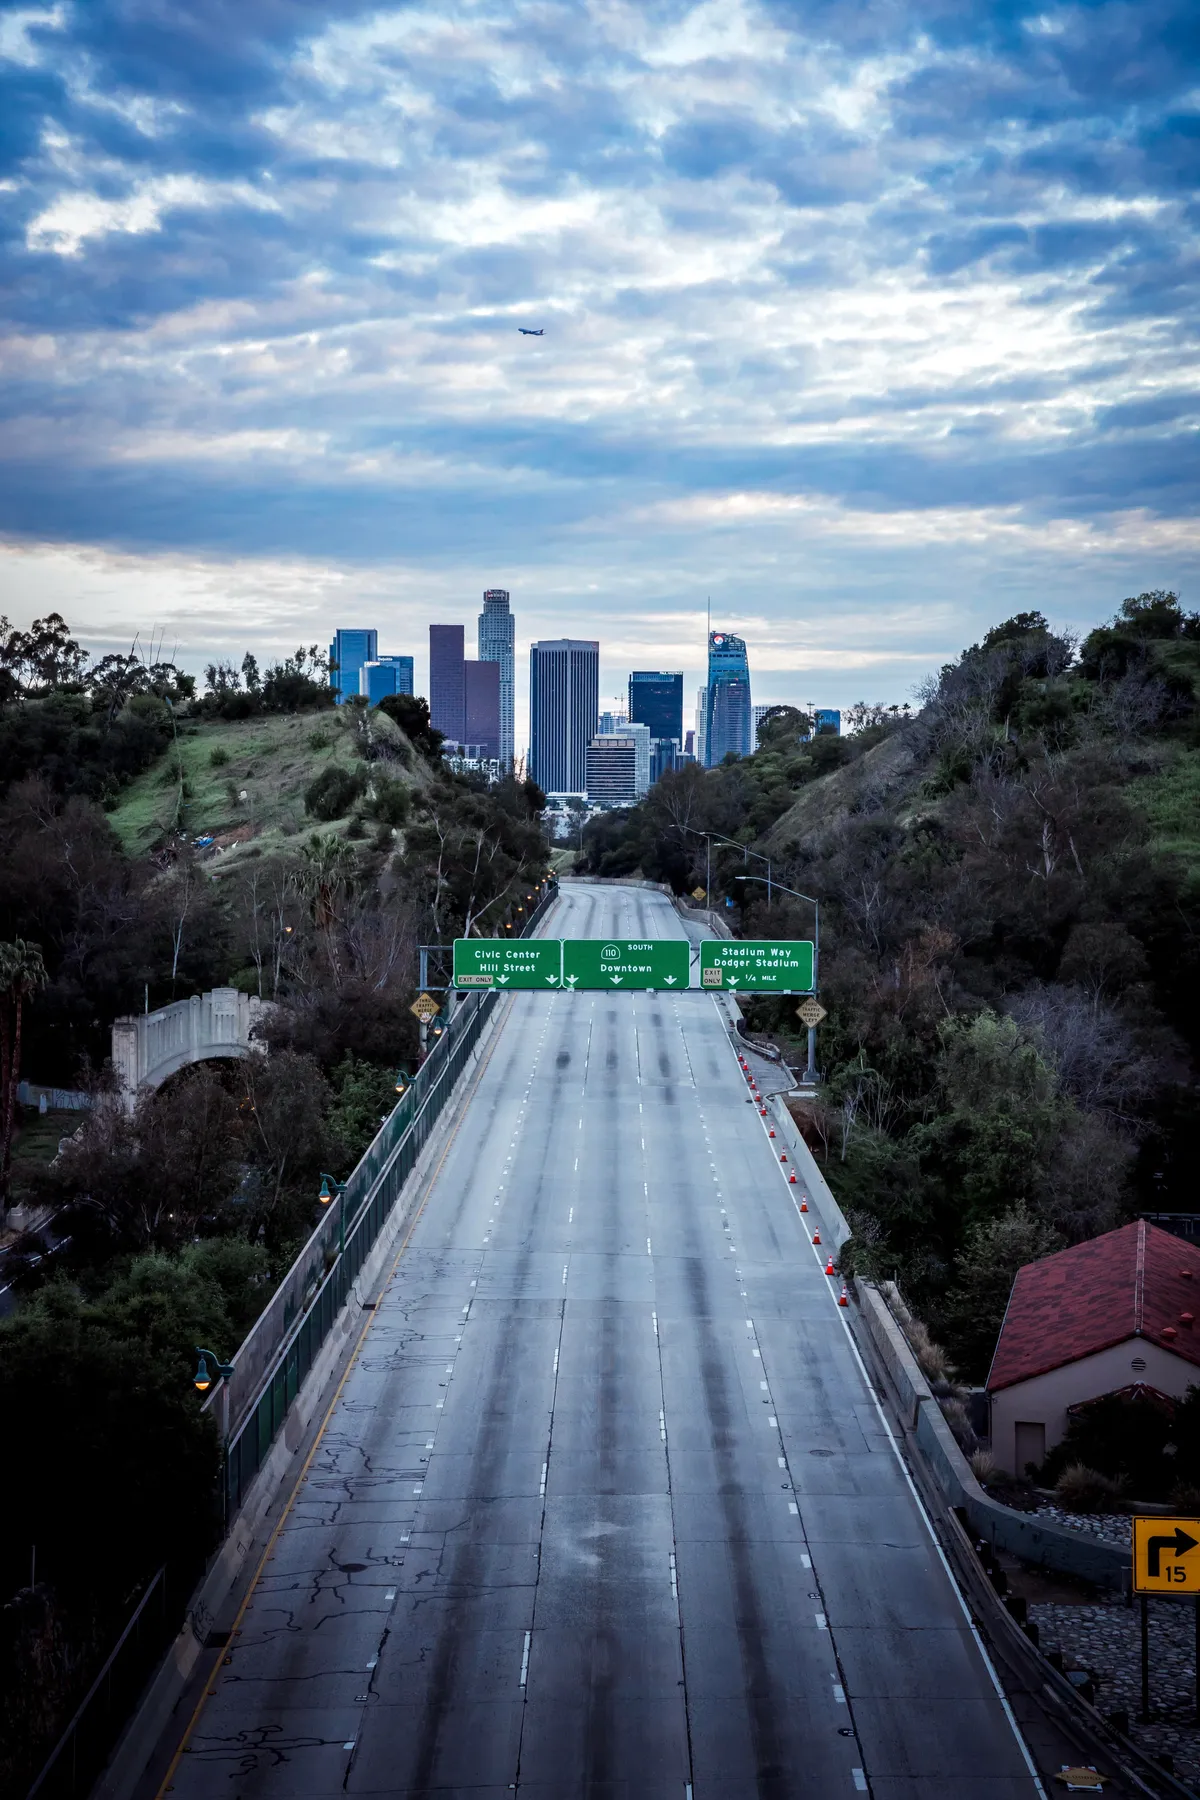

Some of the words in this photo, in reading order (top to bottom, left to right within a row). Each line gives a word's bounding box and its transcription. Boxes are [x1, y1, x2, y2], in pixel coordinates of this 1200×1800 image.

[722, 948, 764, 956] Stadium
[771, 948, 791, 957] Way
[714, 959, 750, 968] Dodger
[756, 959, 798, 967] Stadium
[1166, 1566, 1187, 1583] 15
